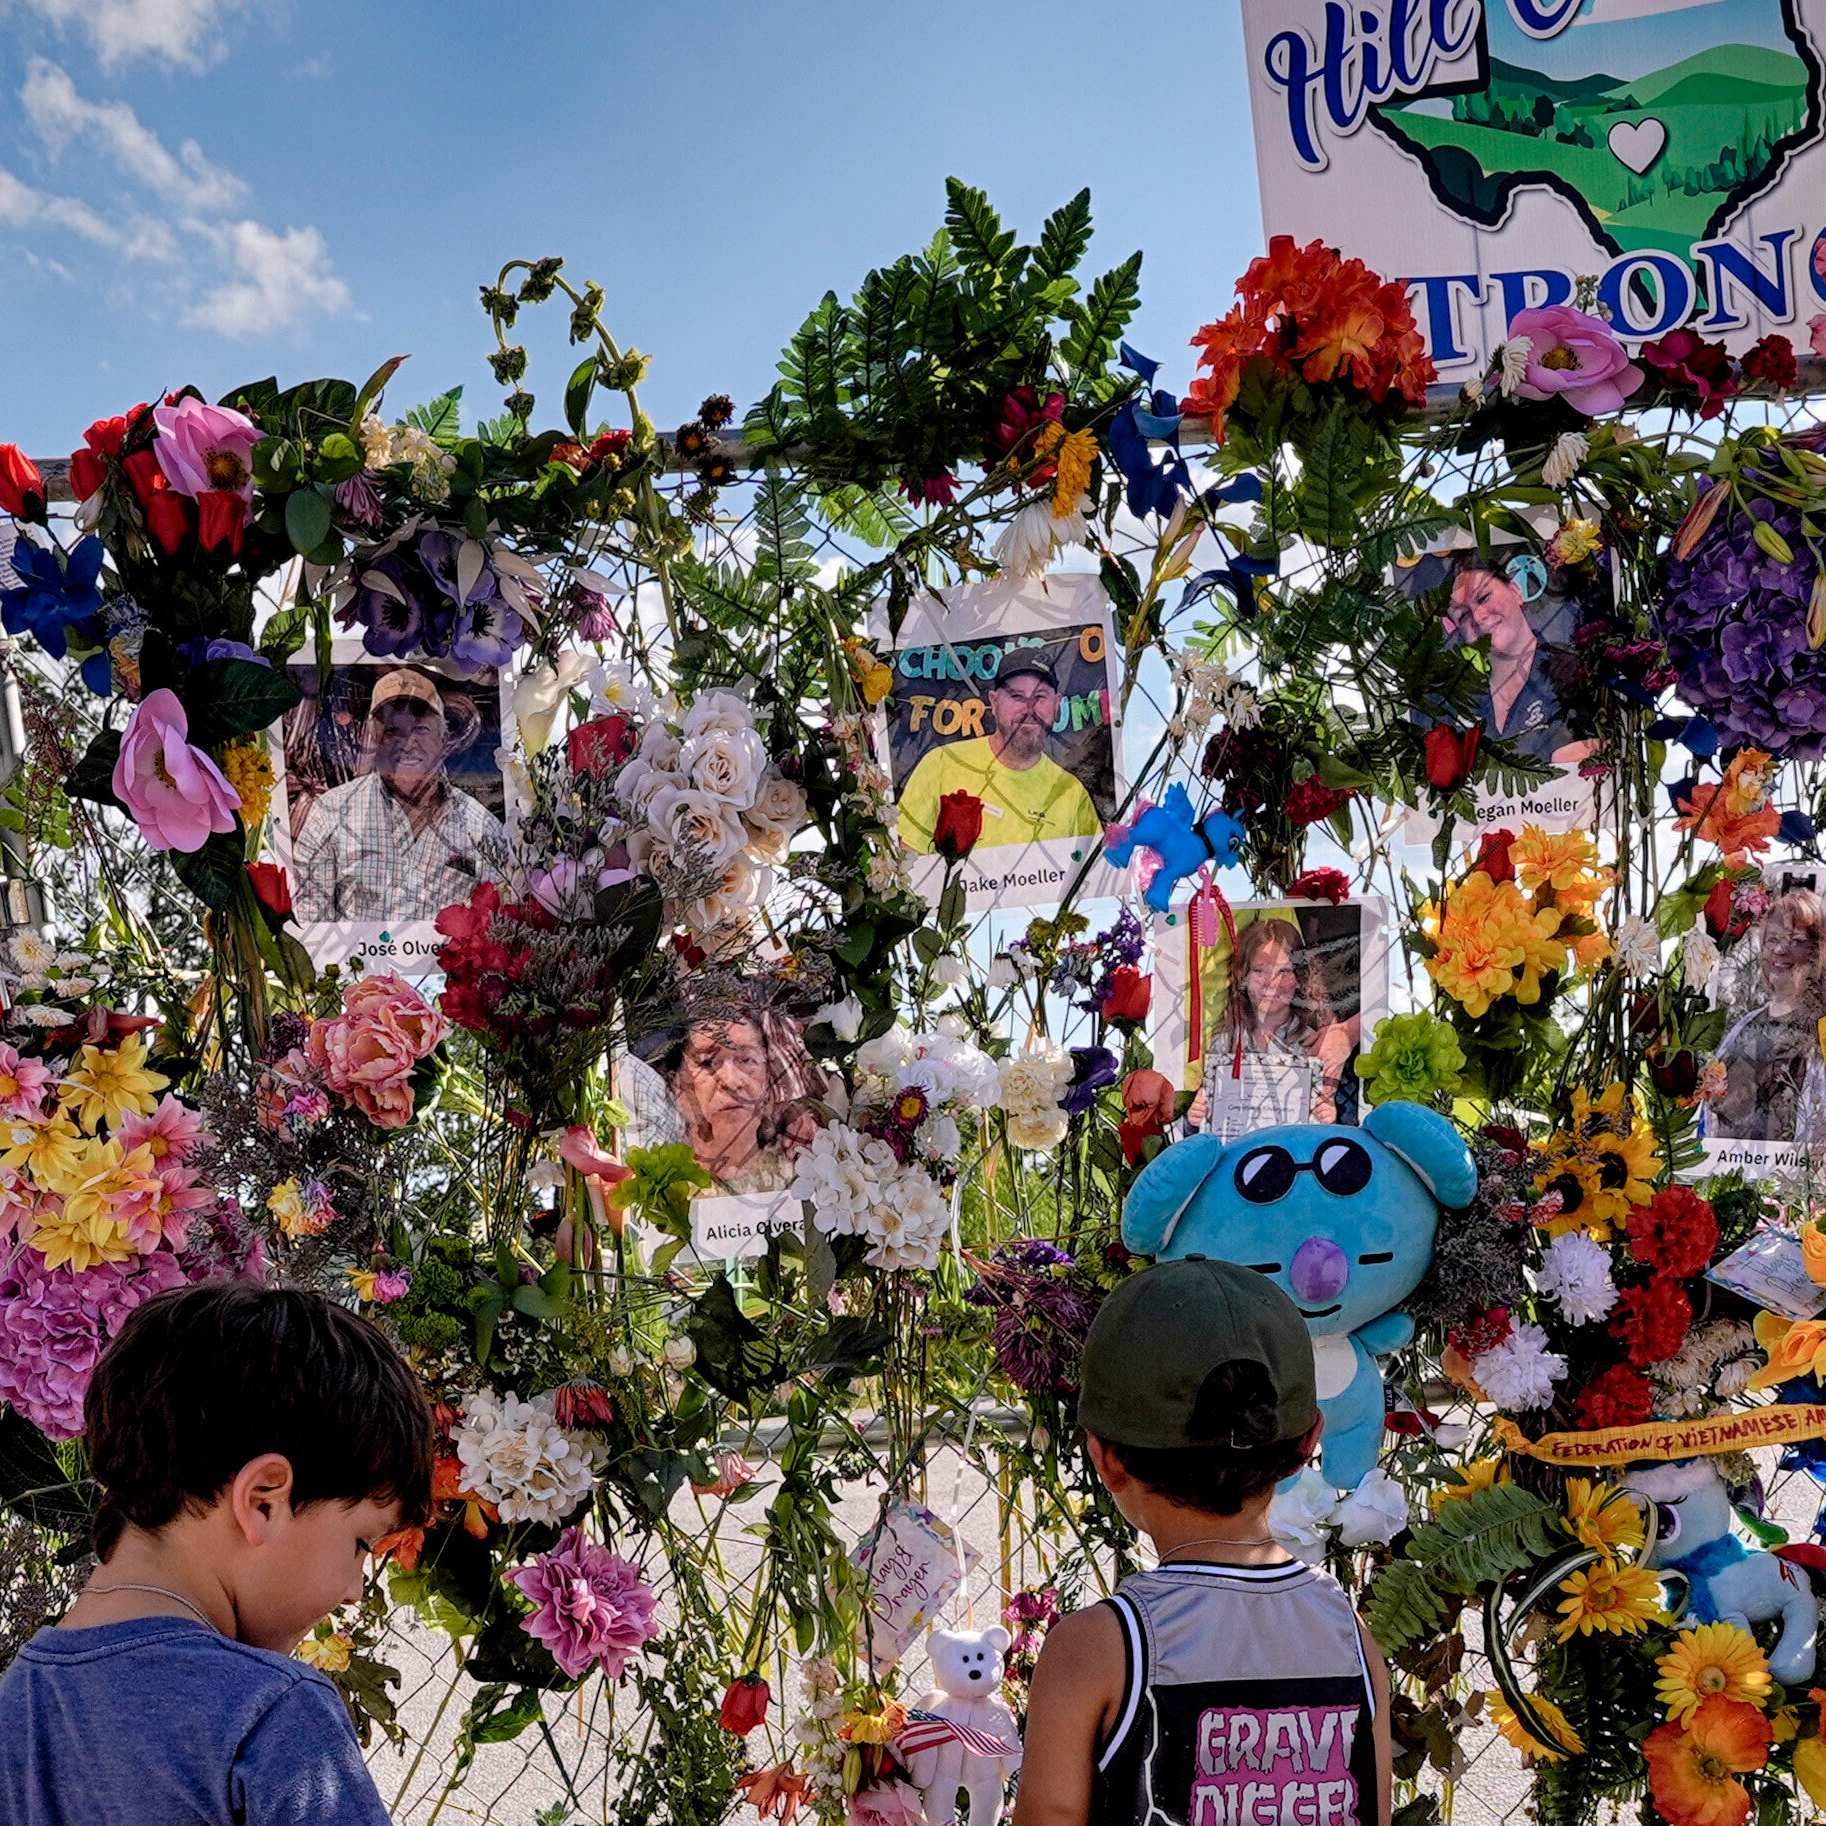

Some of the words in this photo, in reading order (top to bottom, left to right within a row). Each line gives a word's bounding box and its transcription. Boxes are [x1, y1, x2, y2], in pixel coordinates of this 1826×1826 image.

[909, 694, 985, 737] FOR
[1476, 804, 1516, 822] egan
[1521, 797, 1579, 815] Moeller
[958, 876, 998, 894] Jake
[1003, 868, 1066, 889] Moeller
[358, 940, 397, 956] José
[1717, 1150, 1770, 1165] Amber
[1774, 1153, 1824, 1168] Wils
[706, 1223, 752, 1240] Alicia
[756, 1219, 805, 1235] Olvera
[1552, 1434, 1654, 1458] FEDERATION
[1677, 1412, 1798, 1449] VIETNAMESE
[872, 1560, 930, 1631] Prayer
